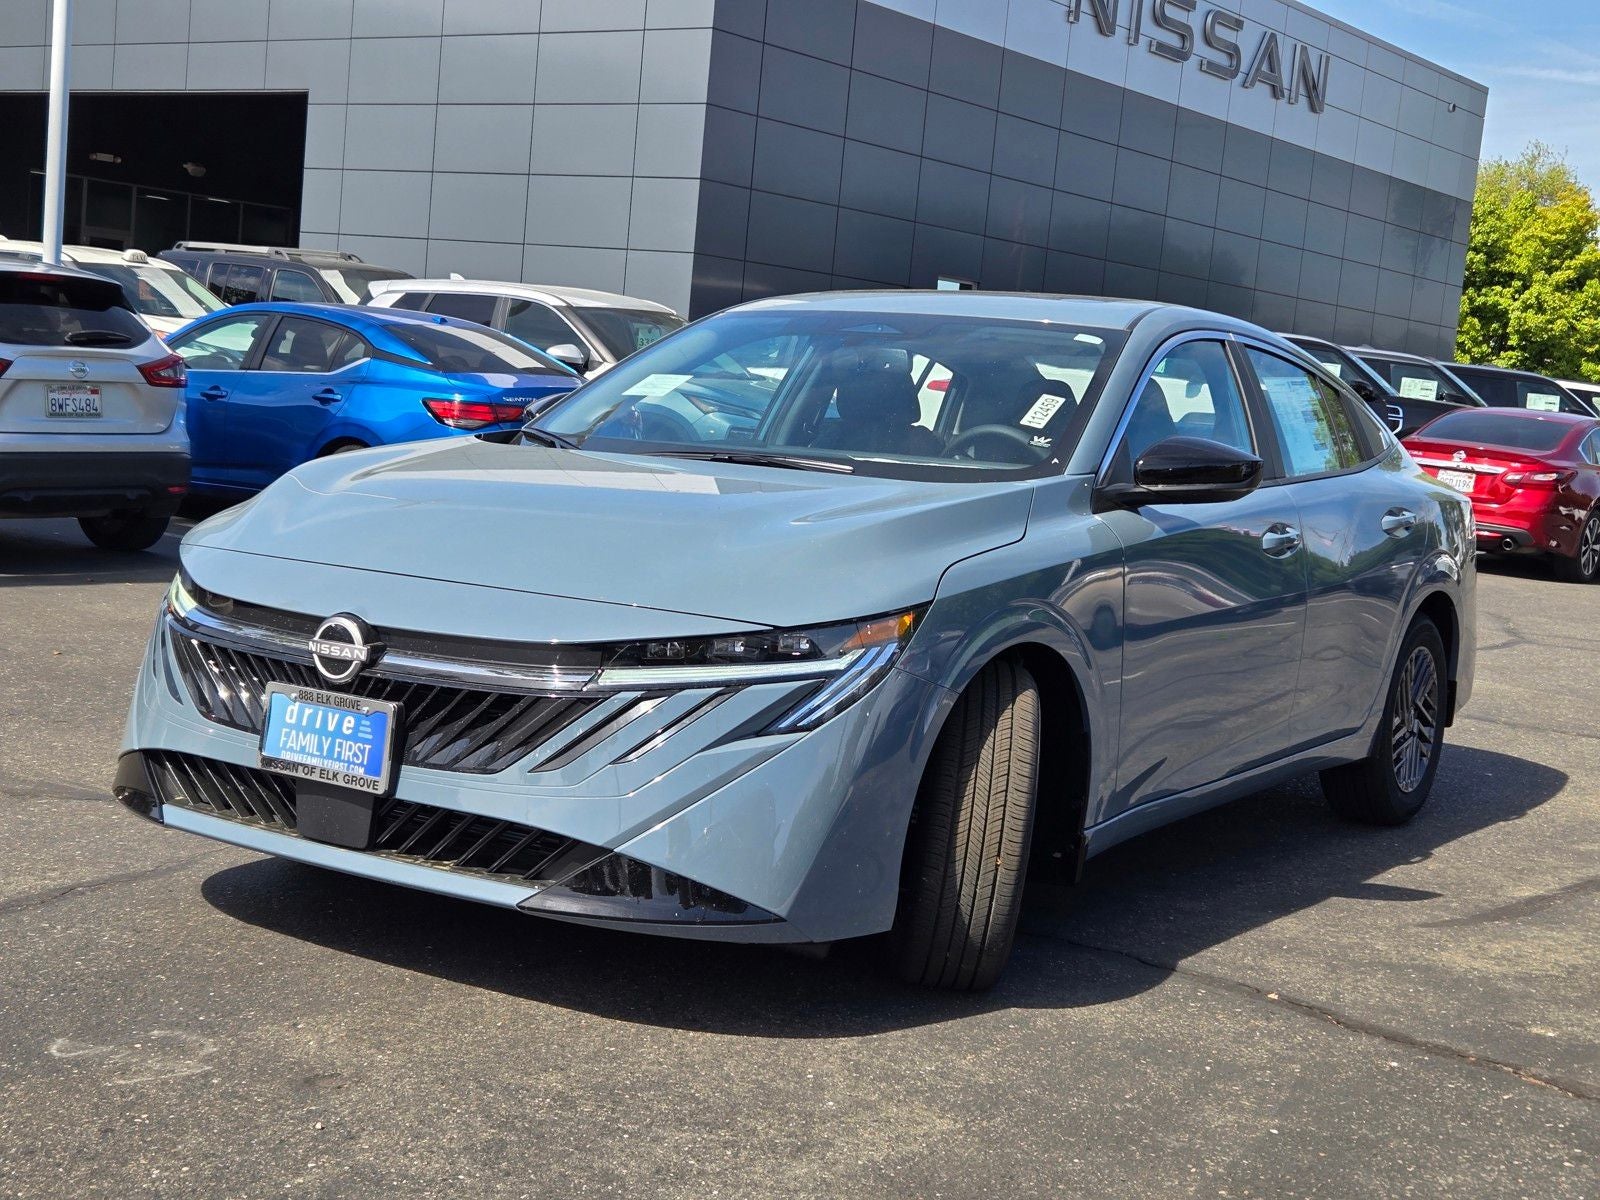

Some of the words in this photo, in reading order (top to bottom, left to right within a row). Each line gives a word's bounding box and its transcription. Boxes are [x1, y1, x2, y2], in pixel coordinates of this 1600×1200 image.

[50, 397, 98, 413] 8WFS484
[1027, 397, 1059, 425] 112459
[308, 640, 365, 660] NISSAN
[316, 692, 332, 705] ELK
[334, 695, 362, 711] GROVE
[285, 701, 355, 735] drive
[279, 728, 332, 756] FAMILY
[334, 738, 372, 765] FIRST
[280, 750, 365, 776] DRIVEFAMILYFIRST.COM
[302, 764, 316, 778] OF
[318, 768, 340, 782] ELK
[342, 773, 380, 791] GROVE
